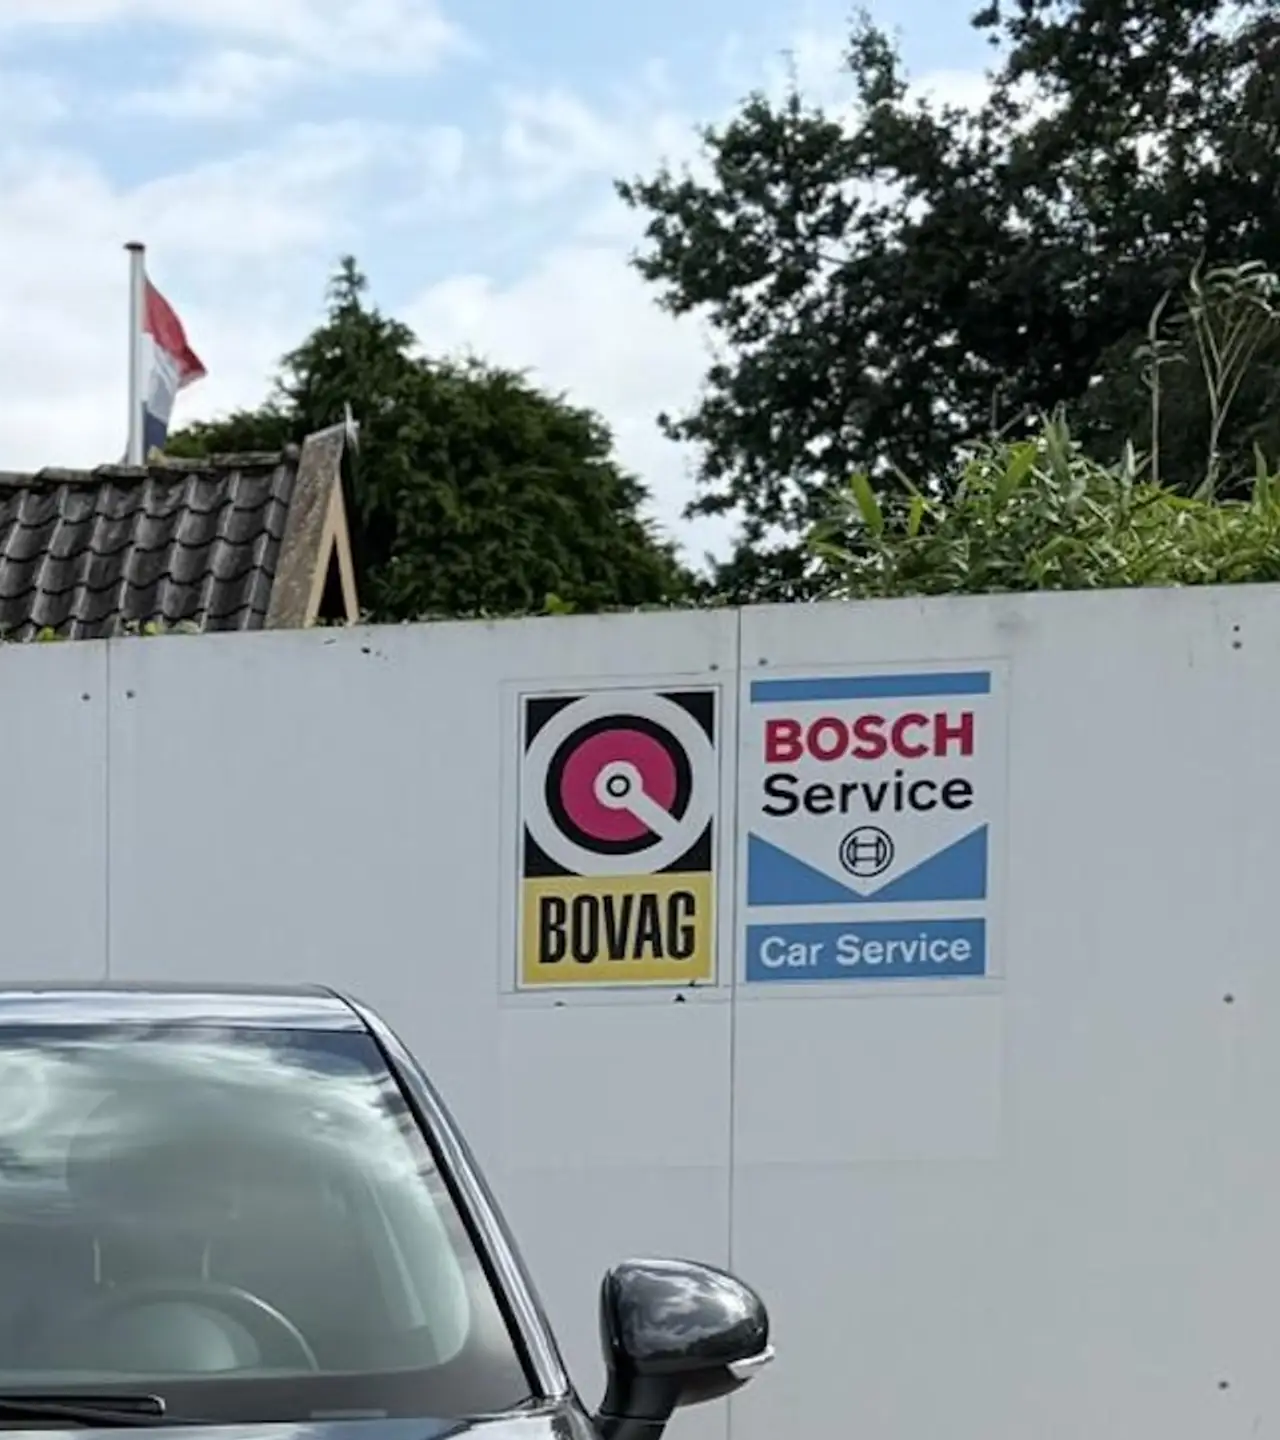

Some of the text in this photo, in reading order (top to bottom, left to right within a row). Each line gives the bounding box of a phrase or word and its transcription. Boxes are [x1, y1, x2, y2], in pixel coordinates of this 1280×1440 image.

[764, 711, 975, 764] BOSCH
[762, 769, 974, 818] Service
[539, 891, 696, 965] BOVAG
[760, 932, 973, 968] Car Service
